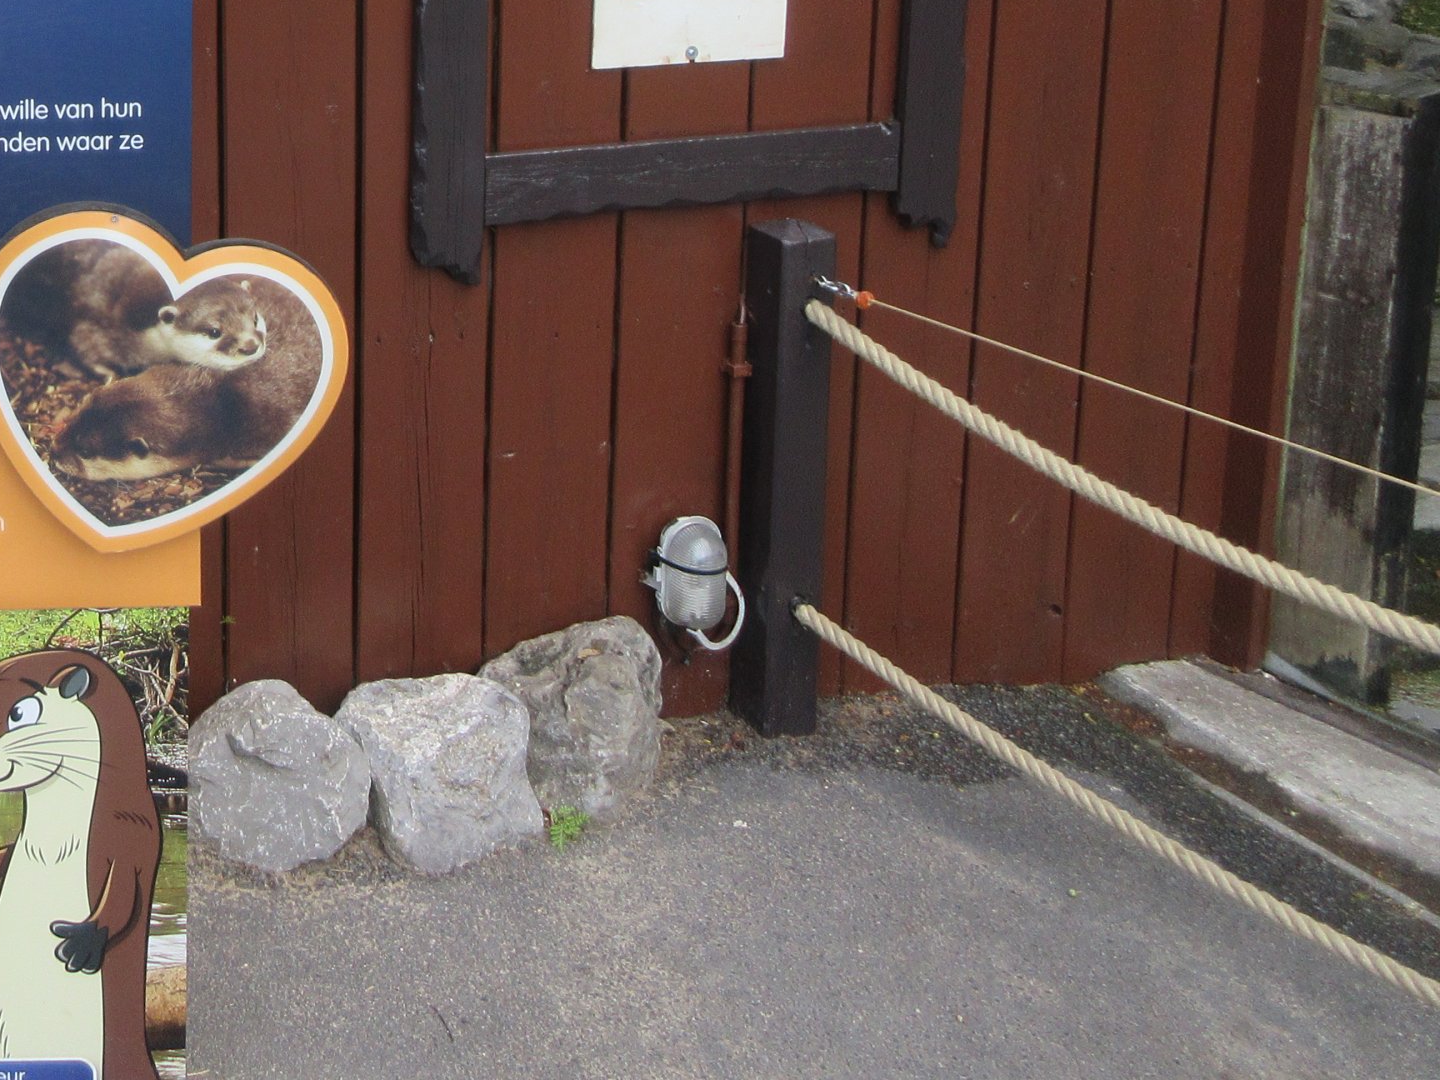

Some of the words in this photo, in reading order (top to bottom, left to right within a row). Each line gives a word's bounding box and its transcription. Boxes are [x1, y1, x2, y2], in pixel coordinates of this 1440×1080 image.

[54, 103, 94, 120] van
[101, 97, 142, 119] hun
[56, 134, 114, 152] waar
[119, 134, 144, 150] ze
